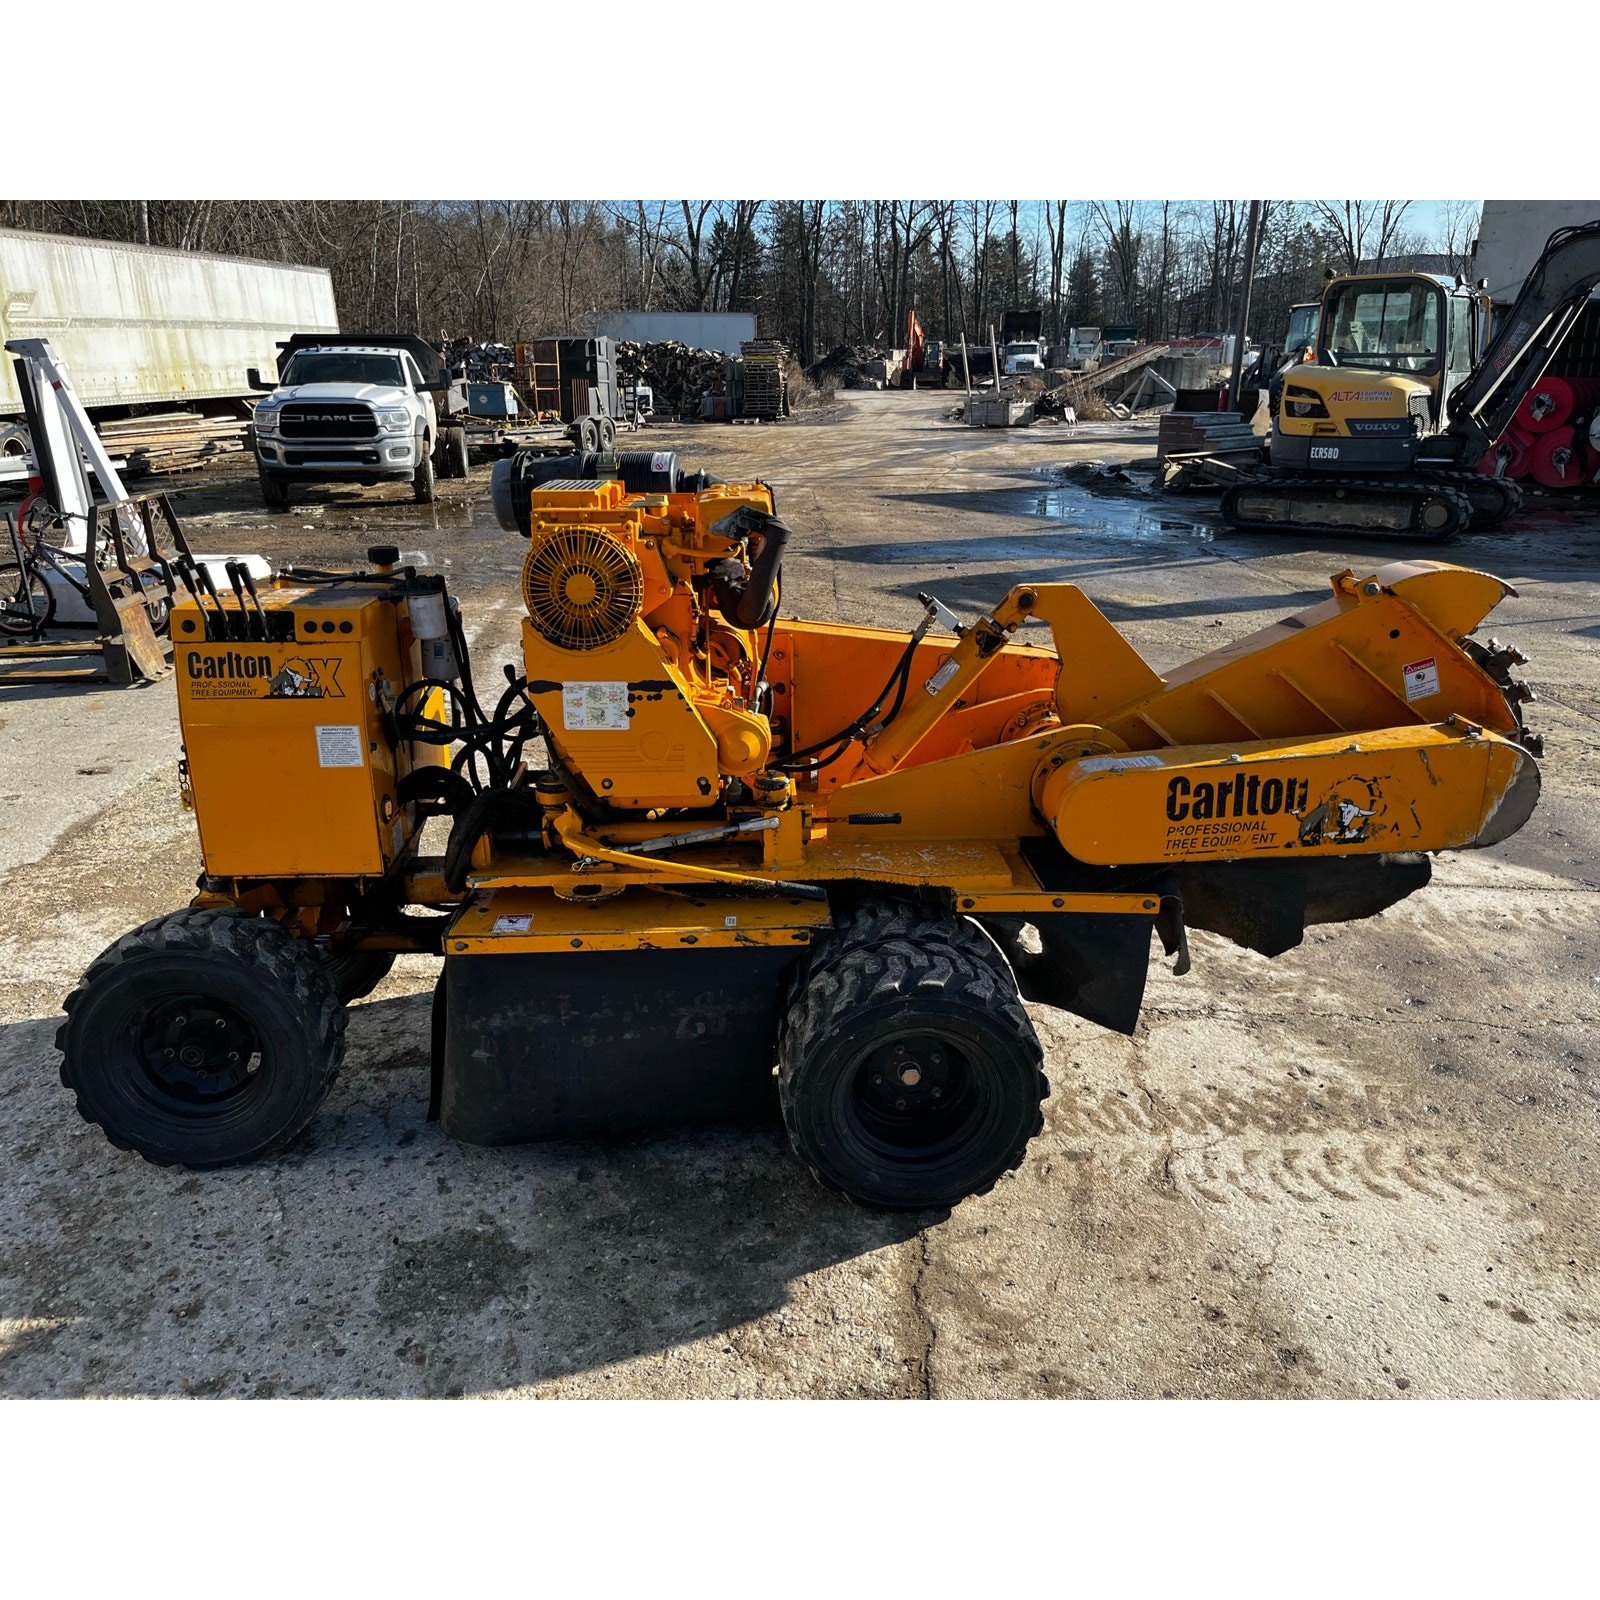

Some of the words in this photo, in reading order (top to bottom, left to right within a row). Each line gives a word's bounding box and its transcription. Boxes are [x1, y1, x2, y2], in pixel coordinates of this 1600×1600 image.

[1327, 391, 1361, 402] ALTA
[1354, 423, 1400, 431] VOLVO
[1310, 447, 1340, 459] ECR58D
[188, 651, 272, 679] Carlton
[1166, 773, 1308, 821] Carlton
[1167, 821, 1268, 836] PROFESSIONAL
[1166, 838, 1198, 849] TREE
[1201, 833, 1277, 847] EQUIPENT
